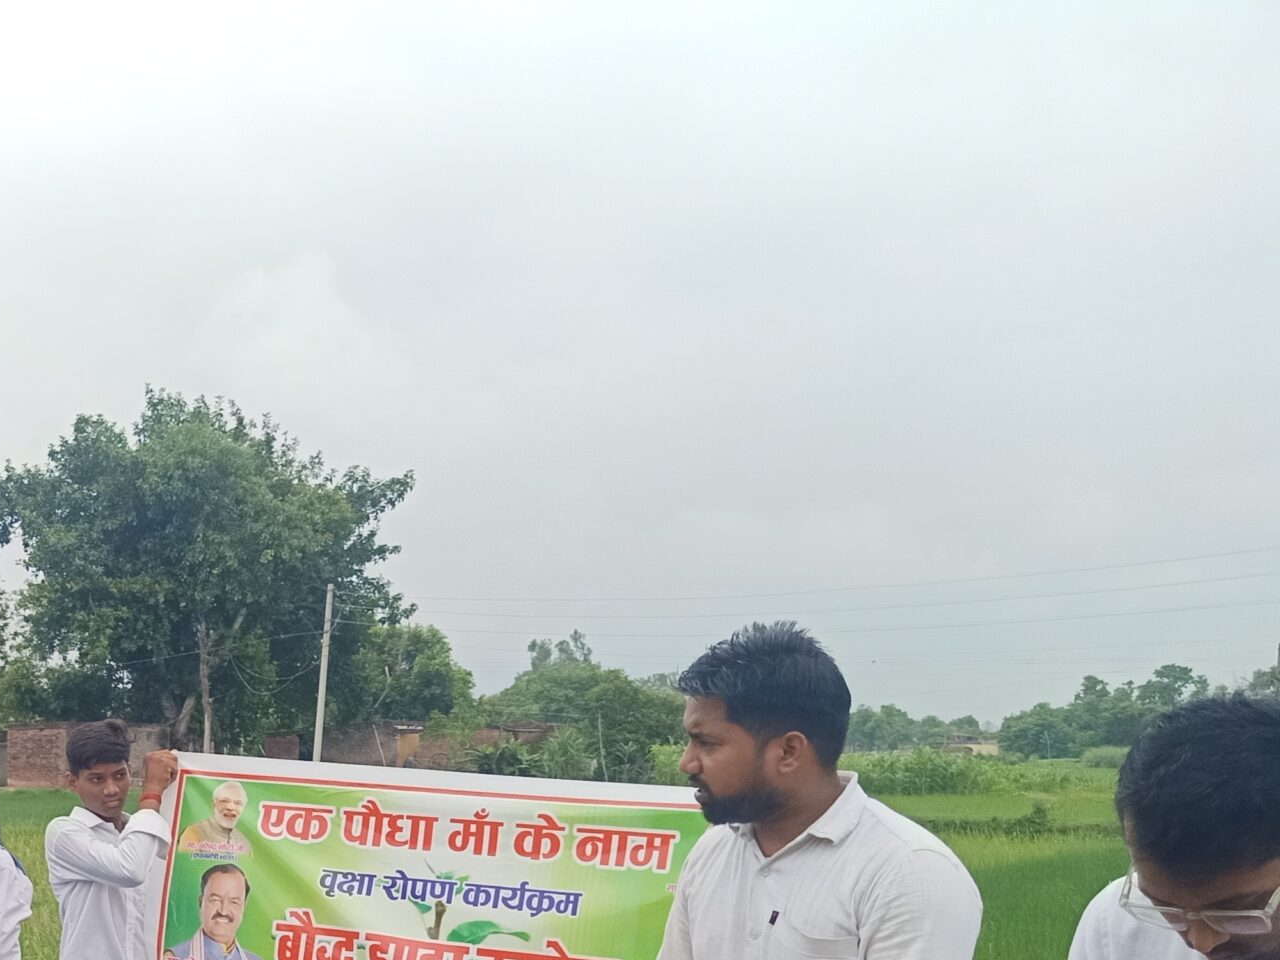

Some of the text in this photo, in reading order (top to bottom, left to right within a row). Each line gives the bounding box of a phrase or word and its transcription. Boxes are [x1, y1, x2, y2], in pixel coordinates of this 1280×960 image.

[261, 799, 676, 870] एक पौधा माँ के नाम
[382, 869, 458, 904] रोपण
[462, 881, 583, 917] कार्यक्रम
